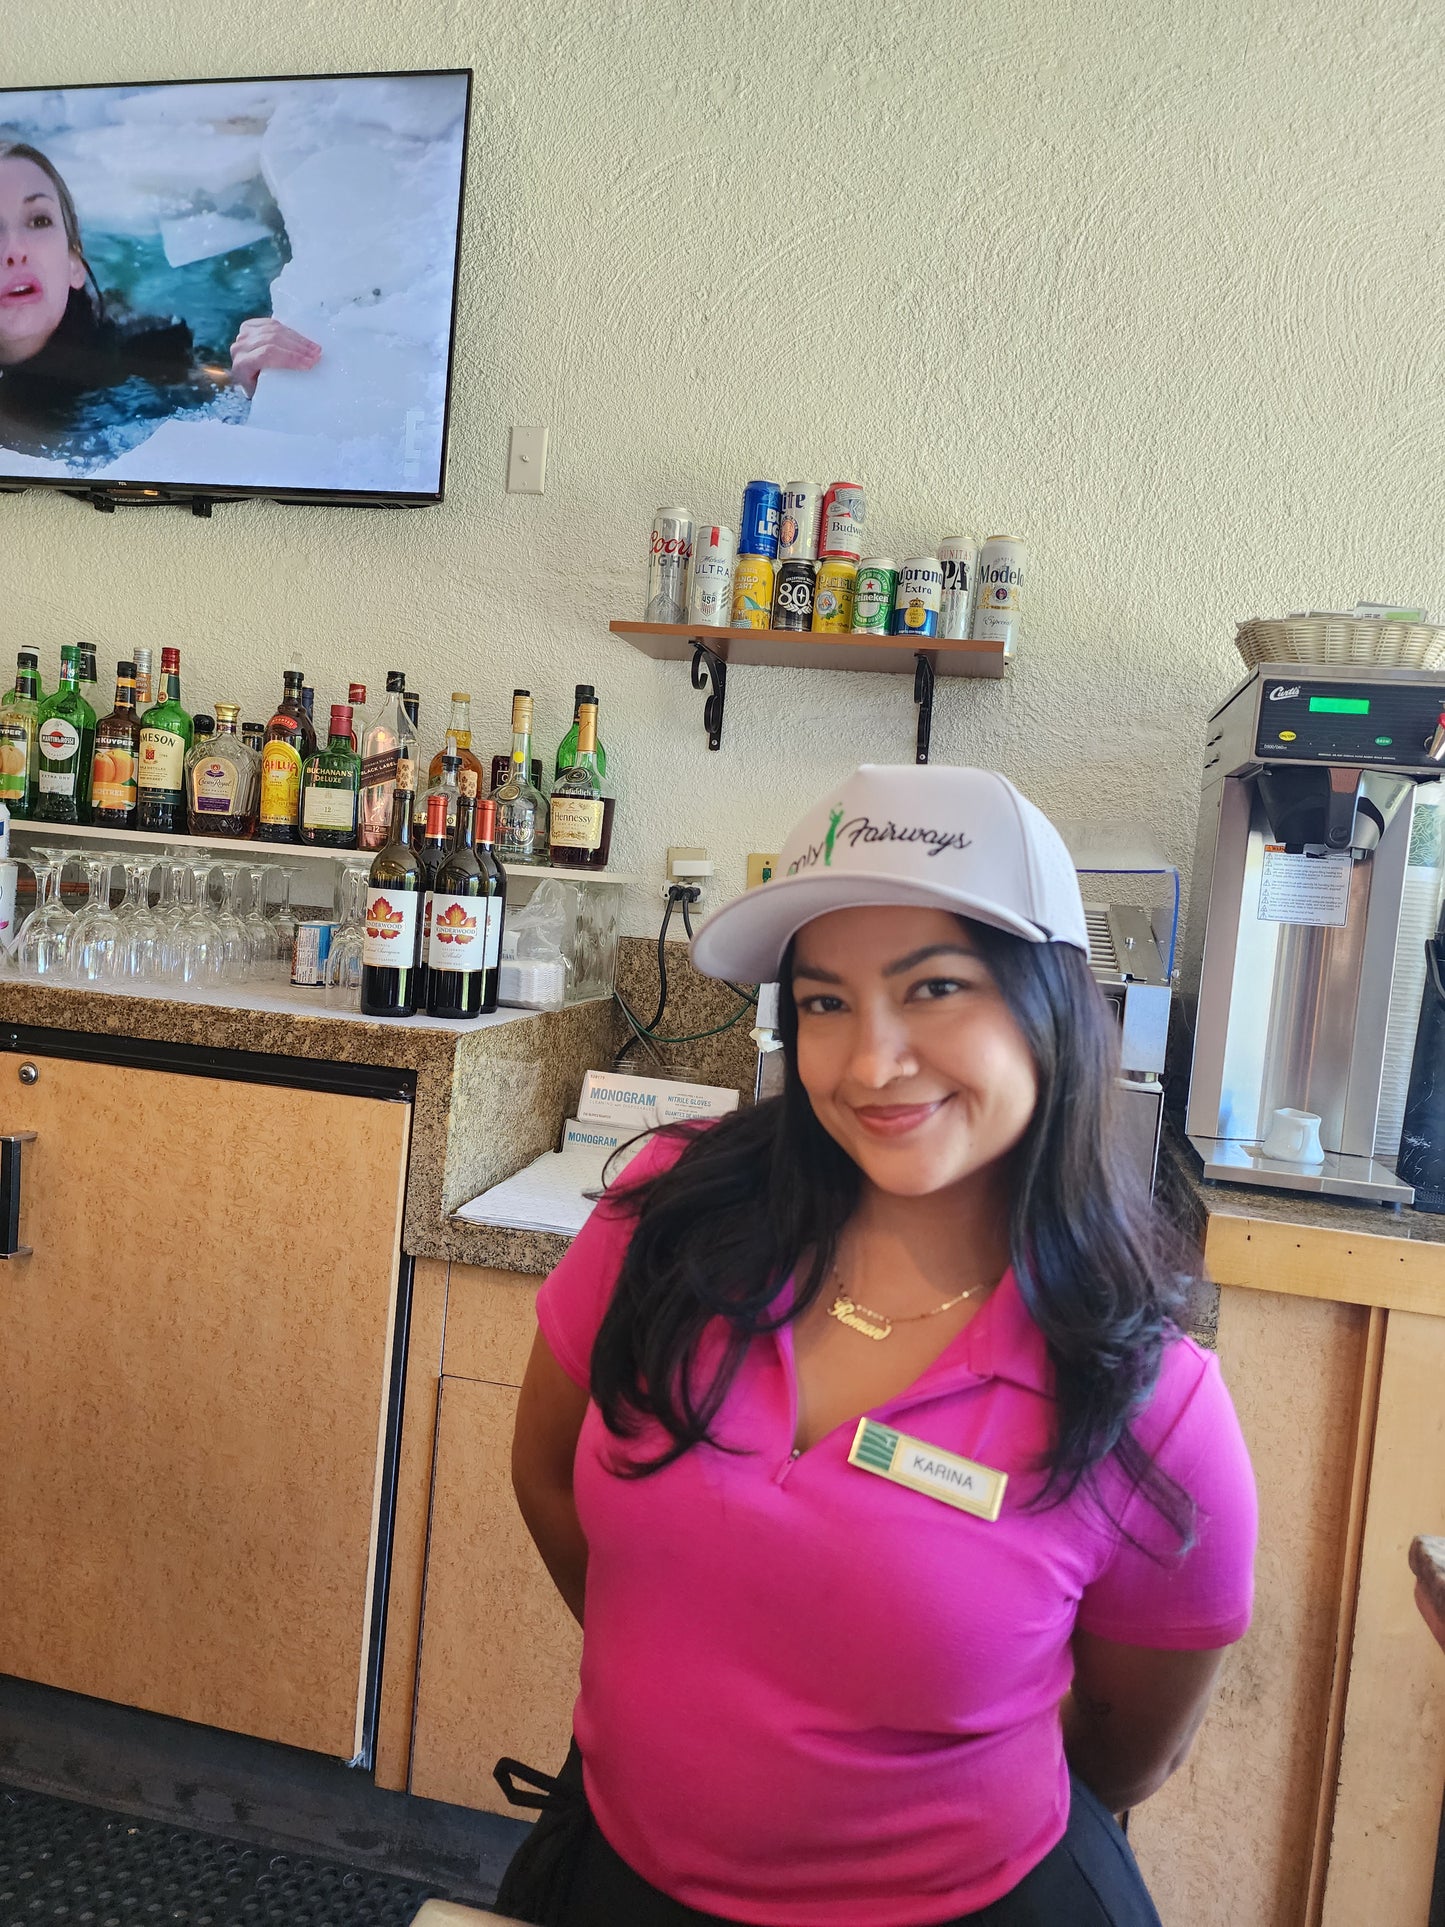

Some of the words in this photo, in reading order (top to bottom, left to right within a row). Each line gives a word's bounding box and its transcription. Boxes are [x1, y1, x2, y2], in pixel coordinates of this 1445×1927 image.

[649, 554, 689, 570] IGHT
[695, 564, 731, 579] ULTRA
[980, 565, 1024, 588] Modelo
[905, 582, 932, 595] Extra
[1269, 685, 1300, 701] Curtis
[306, 766, 353, 777] BUCHANAN'S
[554, 812, 593, 824] Hennessy
[837, 817, 972, 856] Fairways
[590, 1087, 656, 1107] MONOGRAM
[689, 1098, 712, 1107] GLOVES
[567, 1131, 617, 1147] MONOGRAM
[913, 1454, 975, 1491] KARINA
